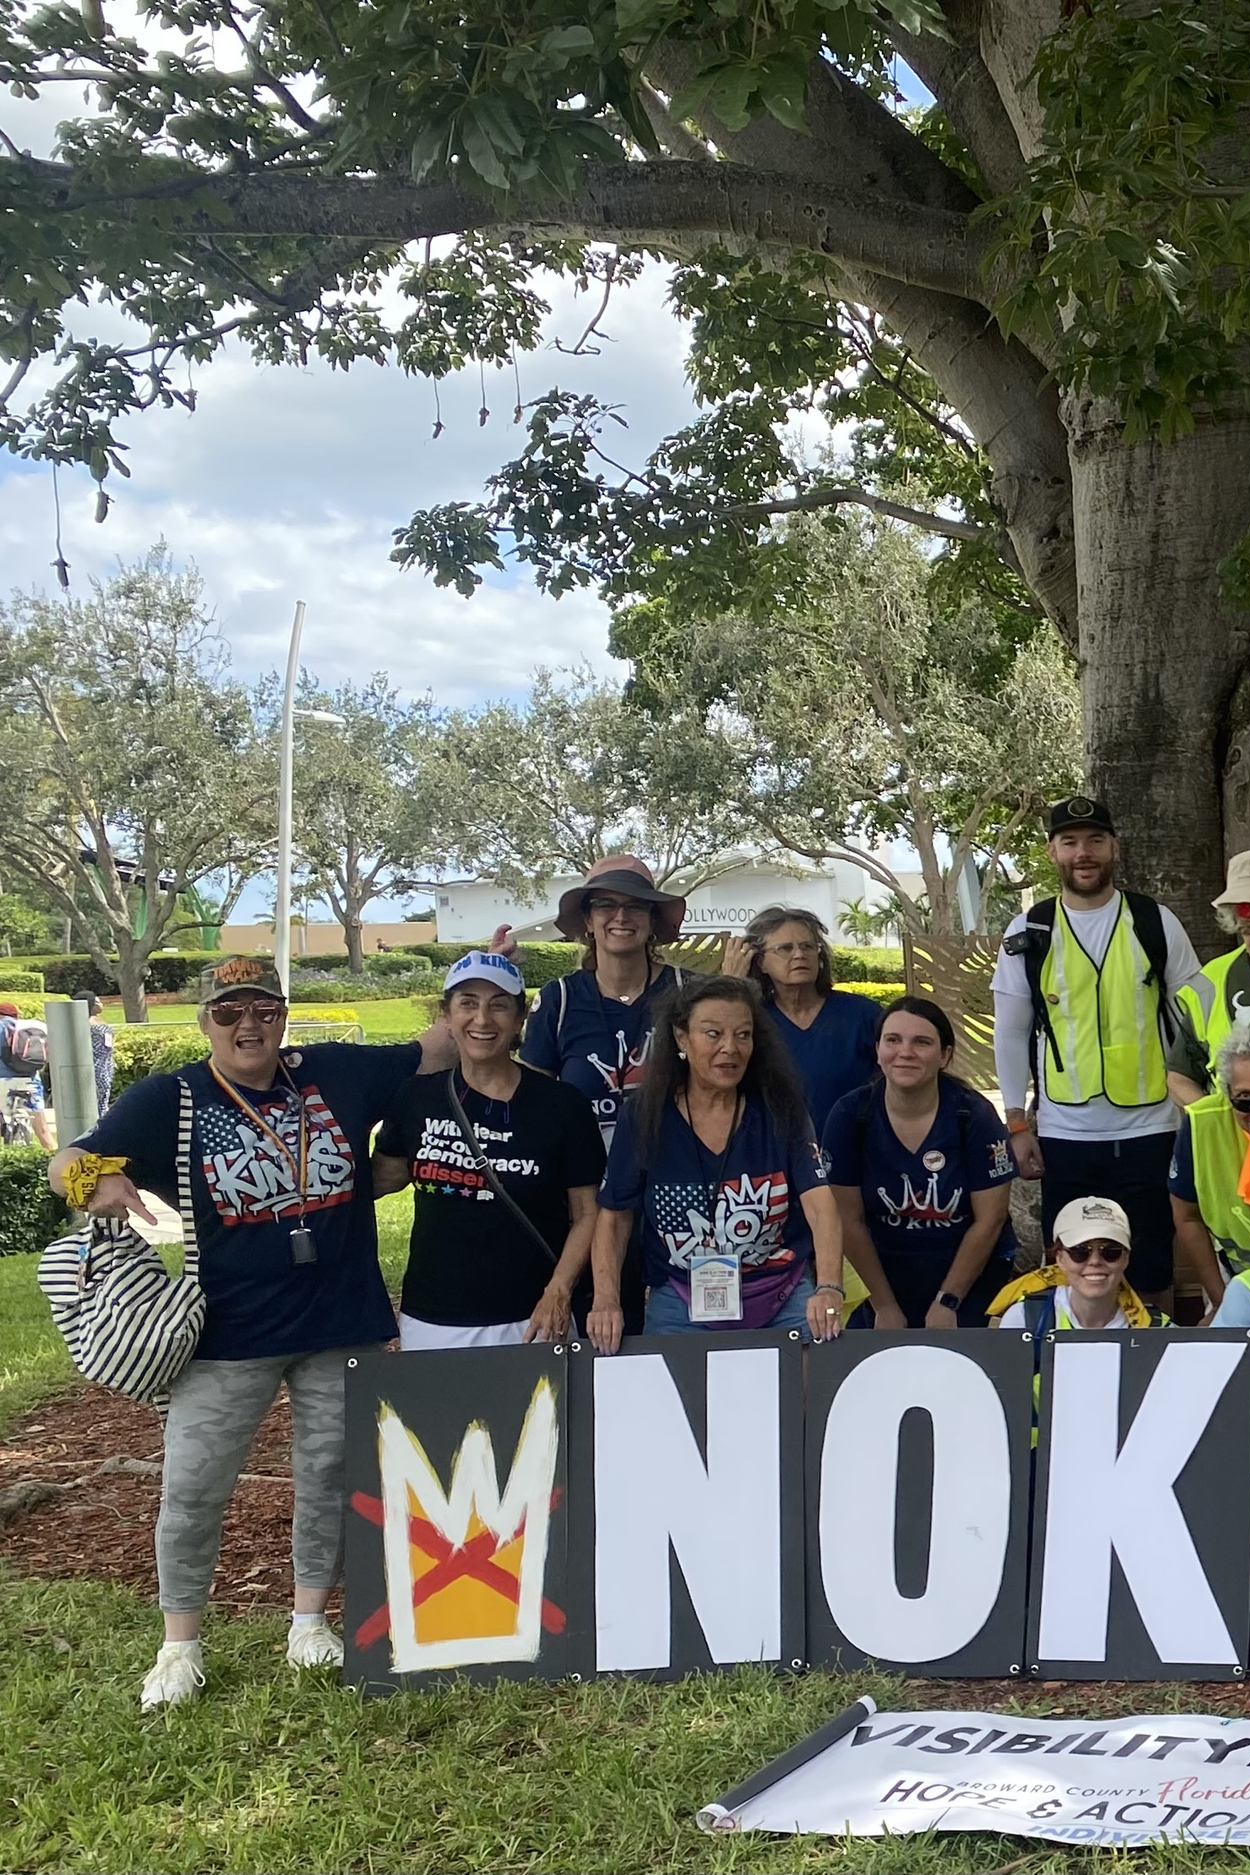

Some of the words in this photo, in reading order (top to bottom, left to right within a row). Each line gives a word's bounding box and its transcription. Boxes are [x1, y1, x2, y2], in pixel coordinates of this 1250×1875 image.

[684, 908, 757, 923] OLLYWOOD
[420, 1131, 450, 1148] for
[473, 1122, 513, 1142] fear
[413, 1161, 418, 1177] I
[416, 1145, 539, 1175] demoracy,
[686, 1200, 760, 1246] NO
[956, 1780, 1056, 1794] BROWARD
[1066, 1786, 1151, 1798] COUNTY
[879, 1780, 1018, 1809] HOPE
[1026, 1800, 1062, 1819] &
